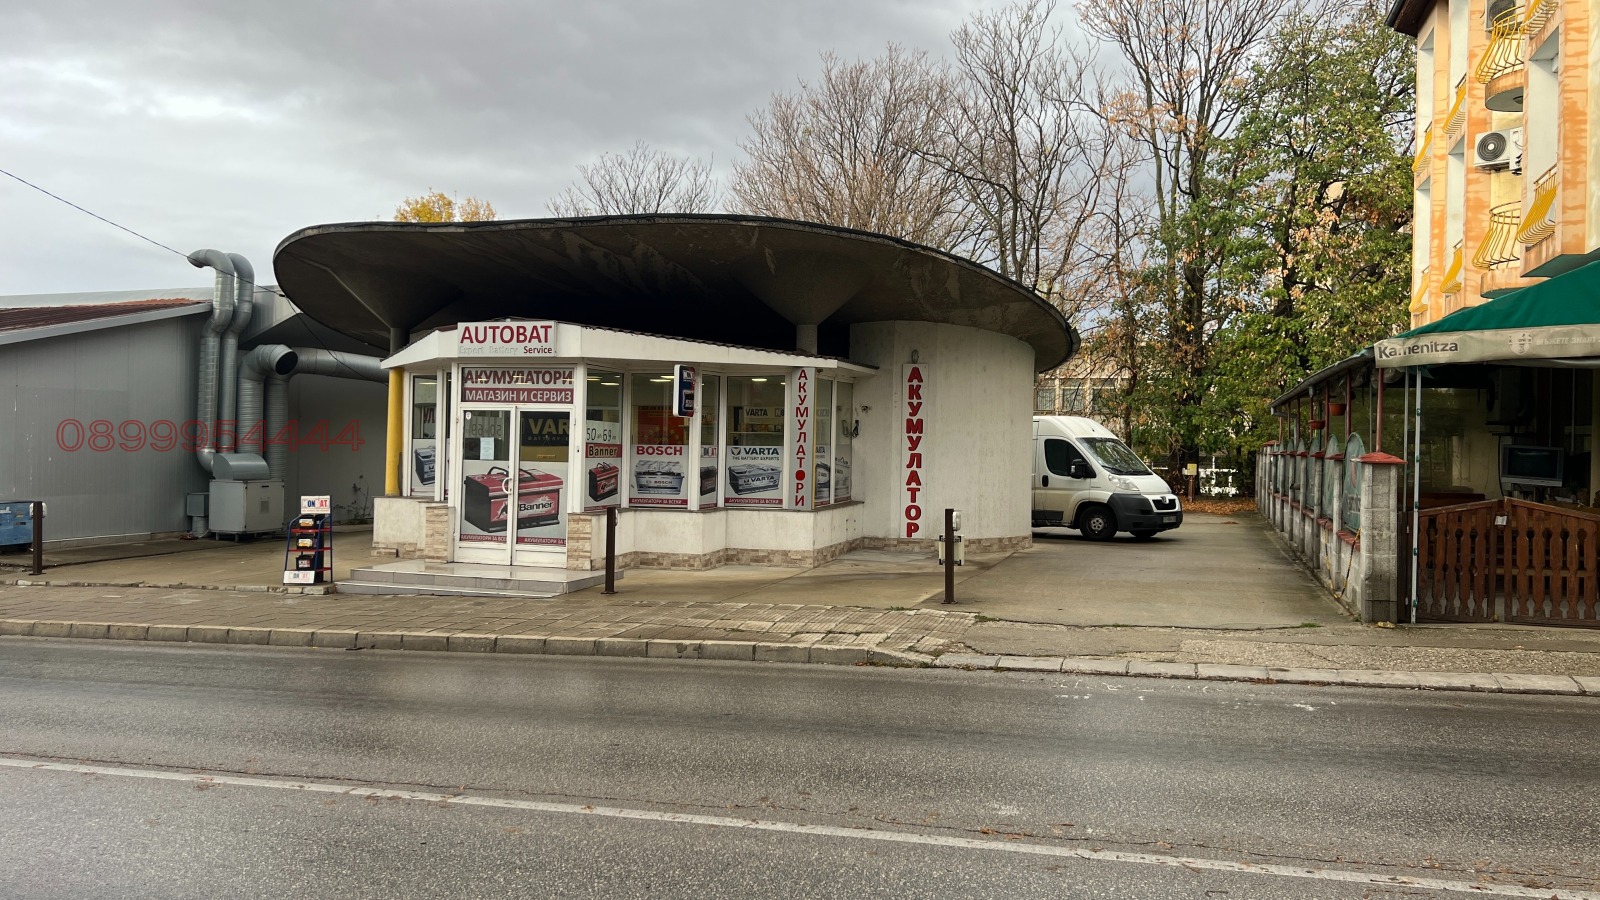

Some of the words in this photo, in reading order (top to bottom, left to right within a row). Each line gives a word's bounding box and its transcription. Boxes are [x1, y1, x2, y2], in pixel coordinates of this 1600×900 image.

[460, 325, 552, 344] AUTOBAT
[460, 346, 484, 355] Expert
[489, 346, 518, 355] Battery
[523, 346, 553, 354] Service
[465, 370, 573, 385] АКУМУЛАТОРИ
[465, 390, 517, 401] МАГАЗИН
[520, 391, 528, 401] И
[530, 391, 572, 402] СЕРВИЗ
[746, 408, 768, 416] VARTA
[586, 428, 597, 441] 50
[602, 429, 612, 442] 69
[588, 445, 617, 456] Banner
[637, 446, 682, 455] BOSCH
[904, 366, 923, 538] АКУМУЛАТОР
[519, 502, 553, 511] Banner
